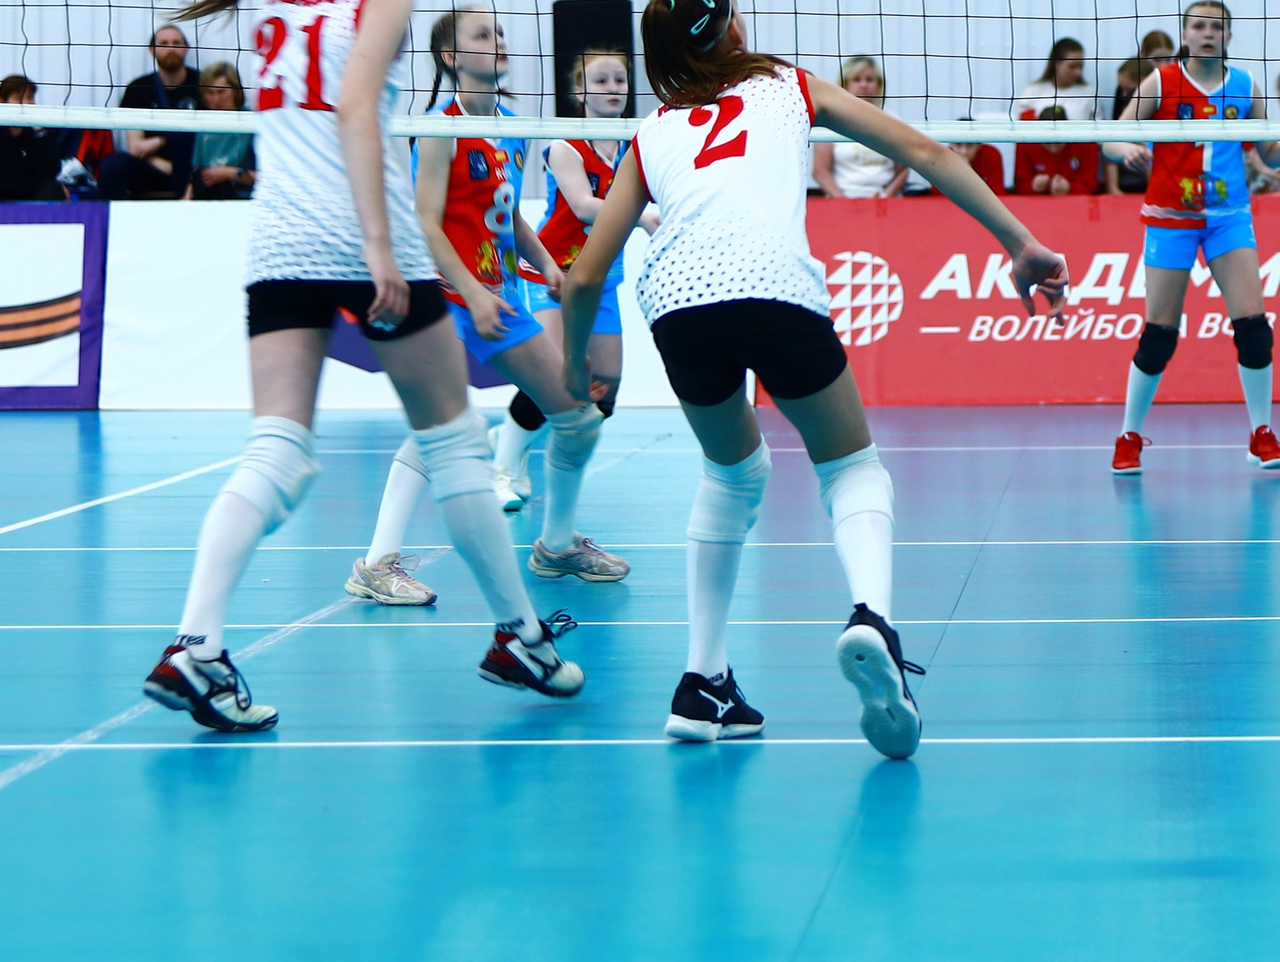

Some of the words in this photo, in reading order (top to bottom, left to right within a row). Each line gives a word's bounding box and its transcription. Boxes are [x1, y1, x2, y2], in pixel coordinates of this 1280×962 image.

[256, 16, 338, 111] 21
[688, 95, 748, 170] 2
[484, 182, 516, 234] 8
